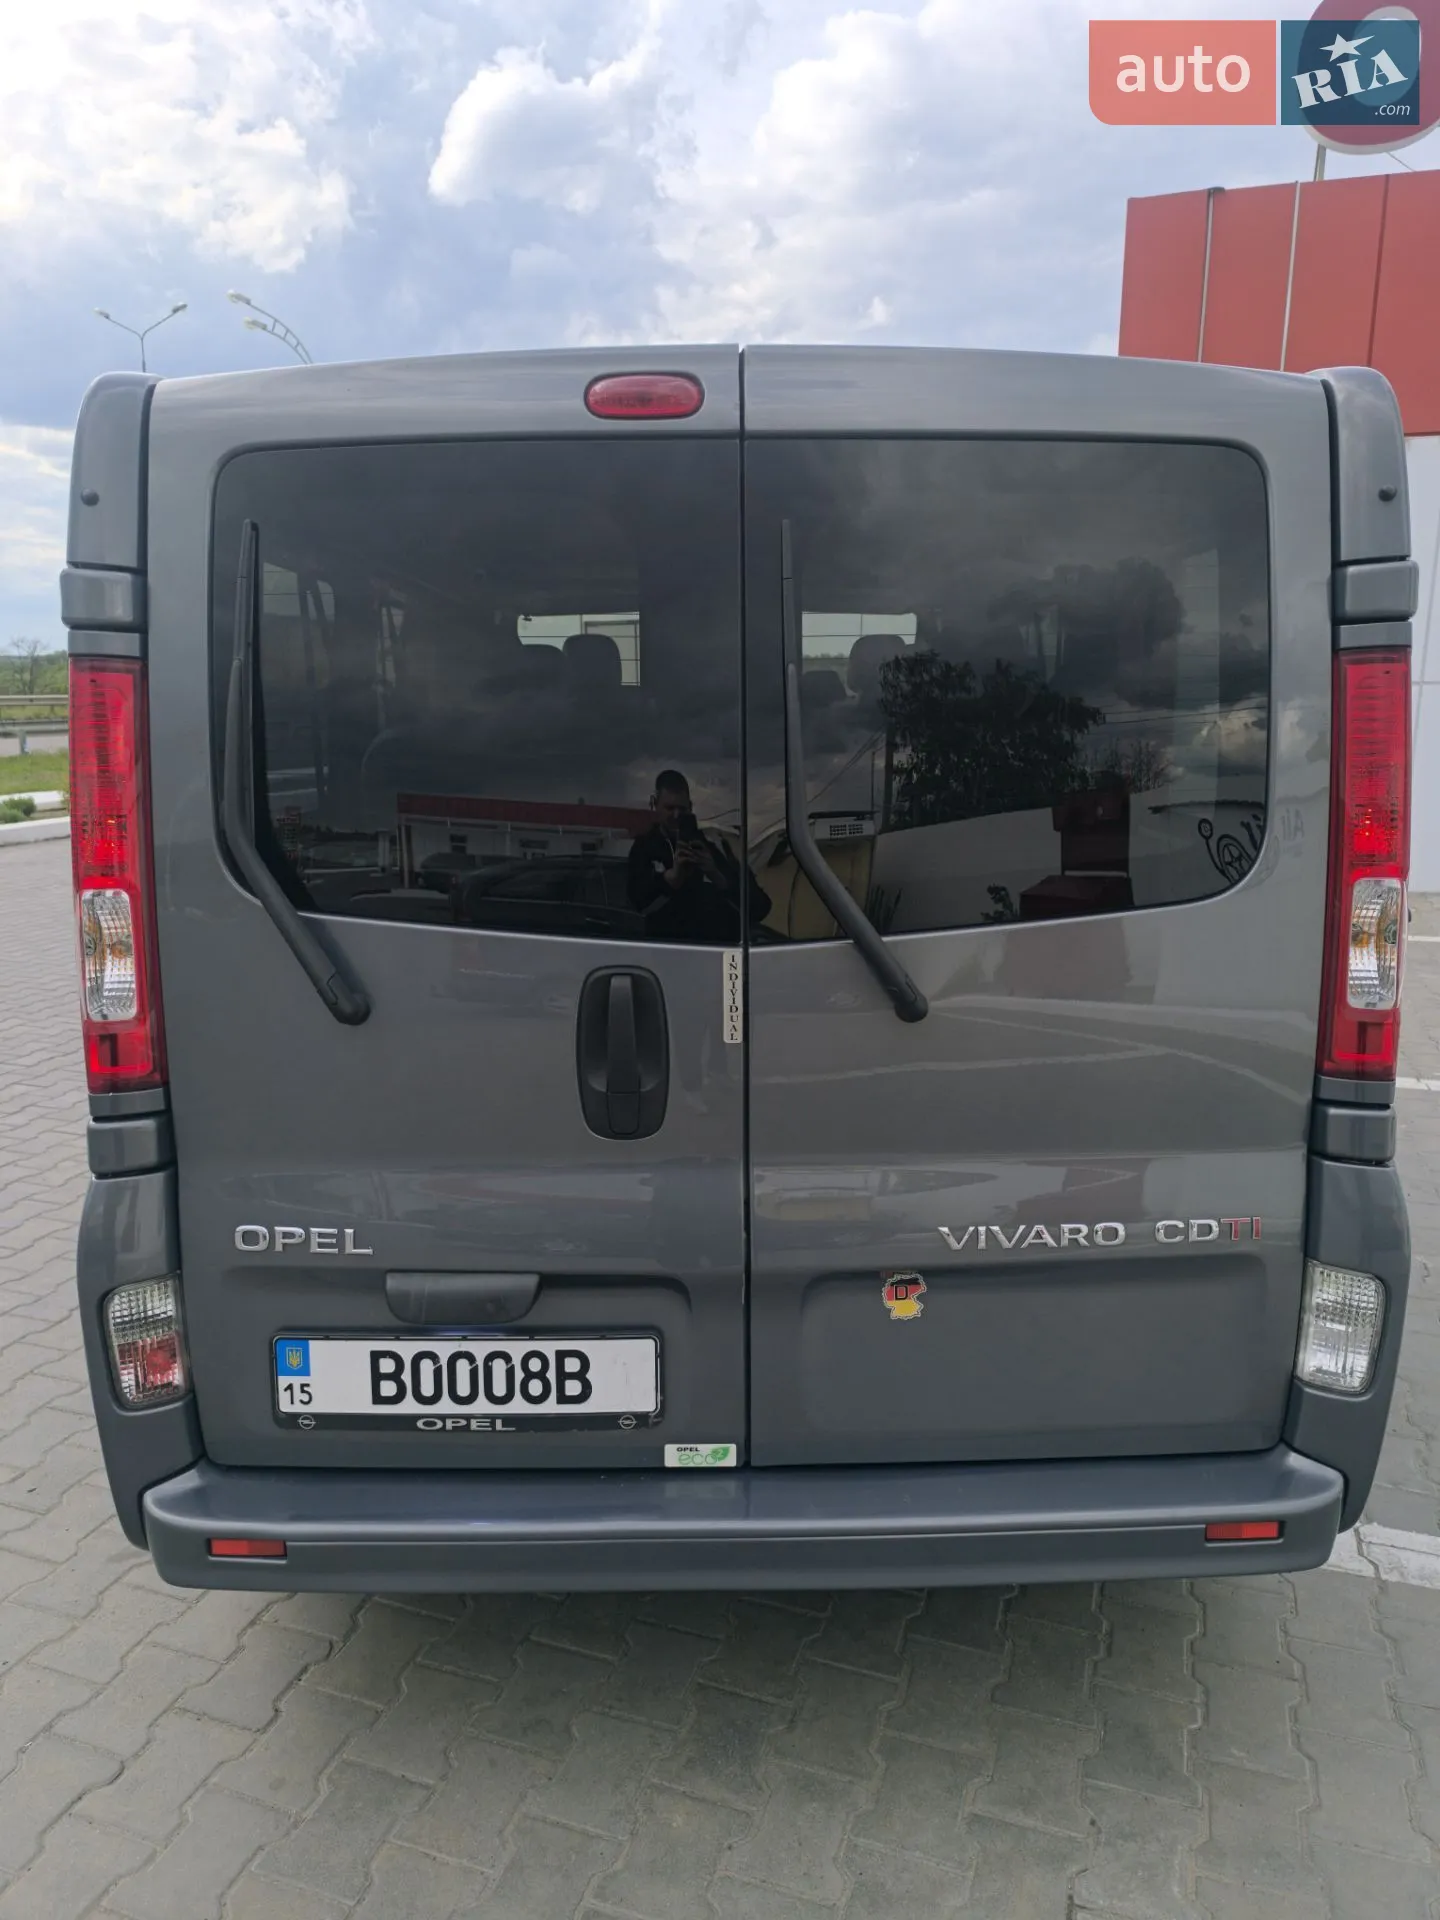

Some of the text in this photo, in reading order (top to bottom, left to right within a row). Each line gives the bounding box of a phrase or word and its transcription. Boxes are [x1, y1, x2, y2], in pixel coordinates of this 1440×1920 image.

[729, 954, 739, 1041] INDIVIDUAL
[234, 1225, 374, 1256] OPEL
[938, 1217, 1262, 1250] VIVARO CDTI
[283, 1383, 313, 1405] 15
[416, 1418, 516, 1431] OPEL
